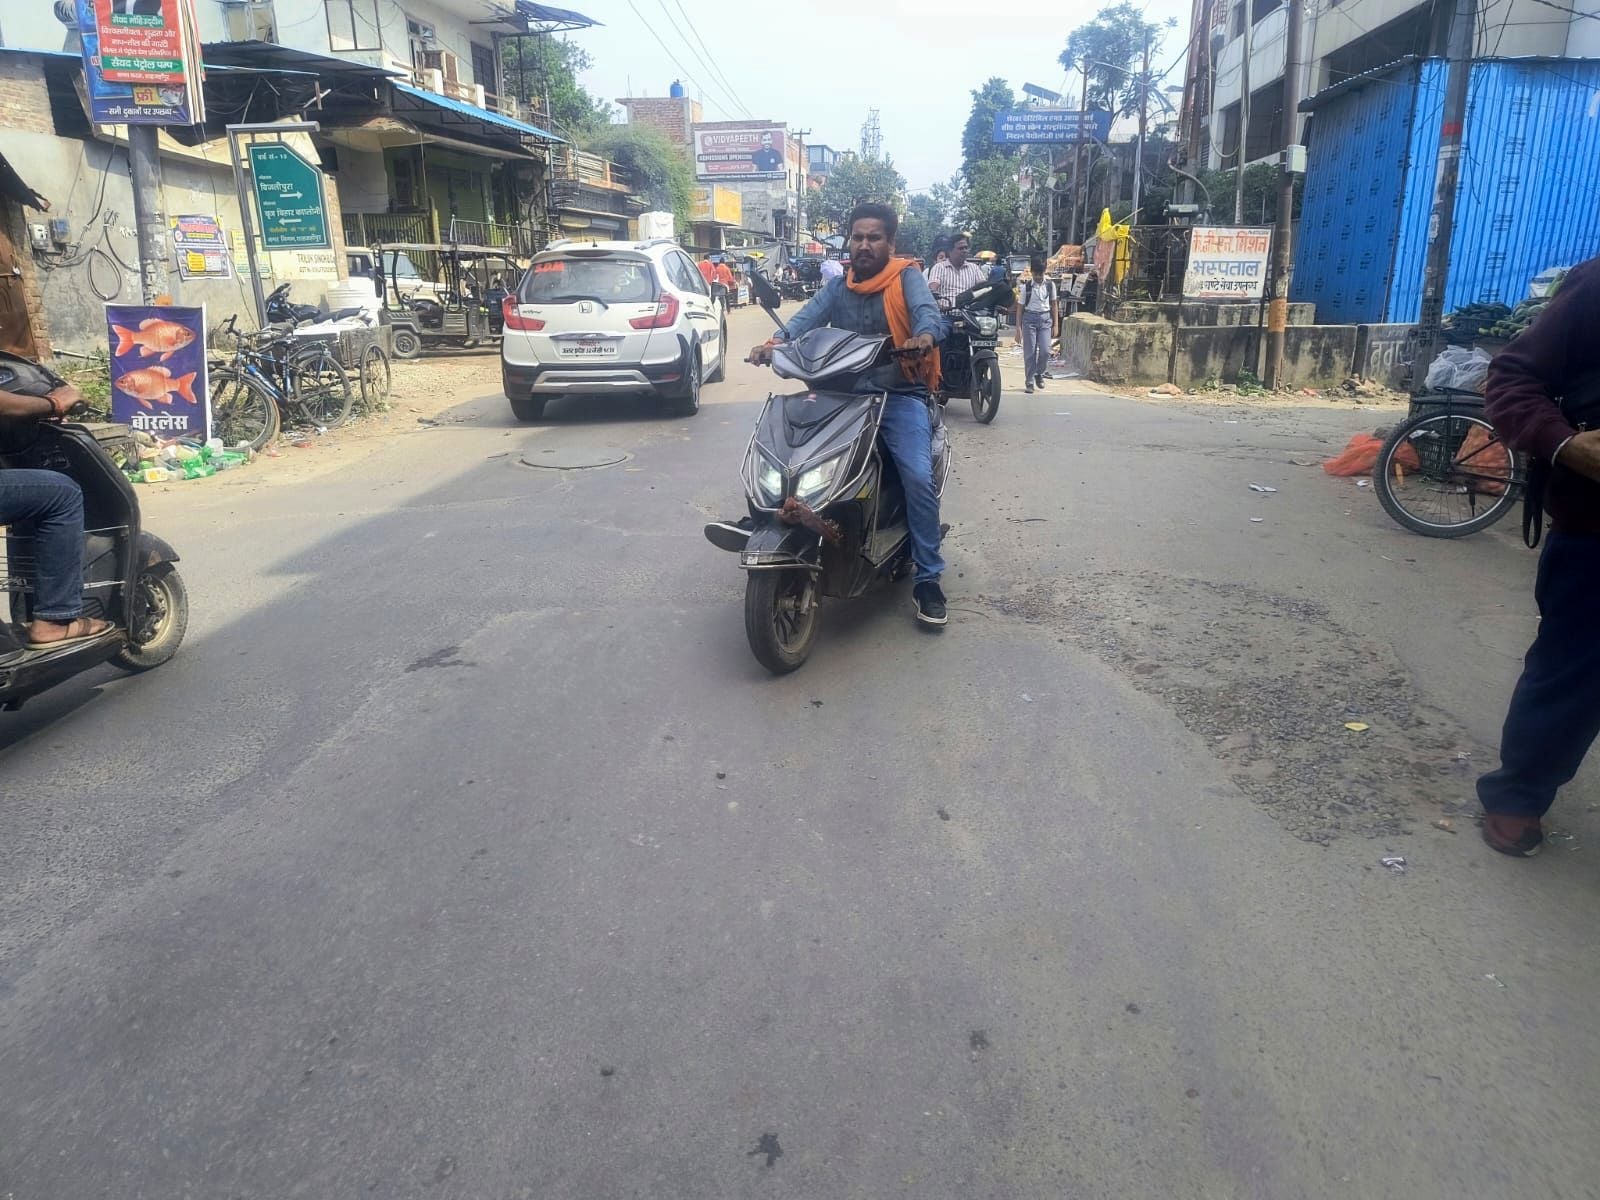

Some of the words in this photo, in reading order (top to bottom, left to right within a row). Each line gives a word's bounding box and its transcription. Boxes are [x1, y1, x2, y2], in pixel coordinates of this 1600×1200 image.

[142, 107, 151, 115] पर
[713, 134, 759, 144] VIDYAPEETH
[1235, 230, 1269, 254] मिशन
[1193, 260, 1262, 276] अस्पताल
[131, 411, 188, 430] बोरलेस
